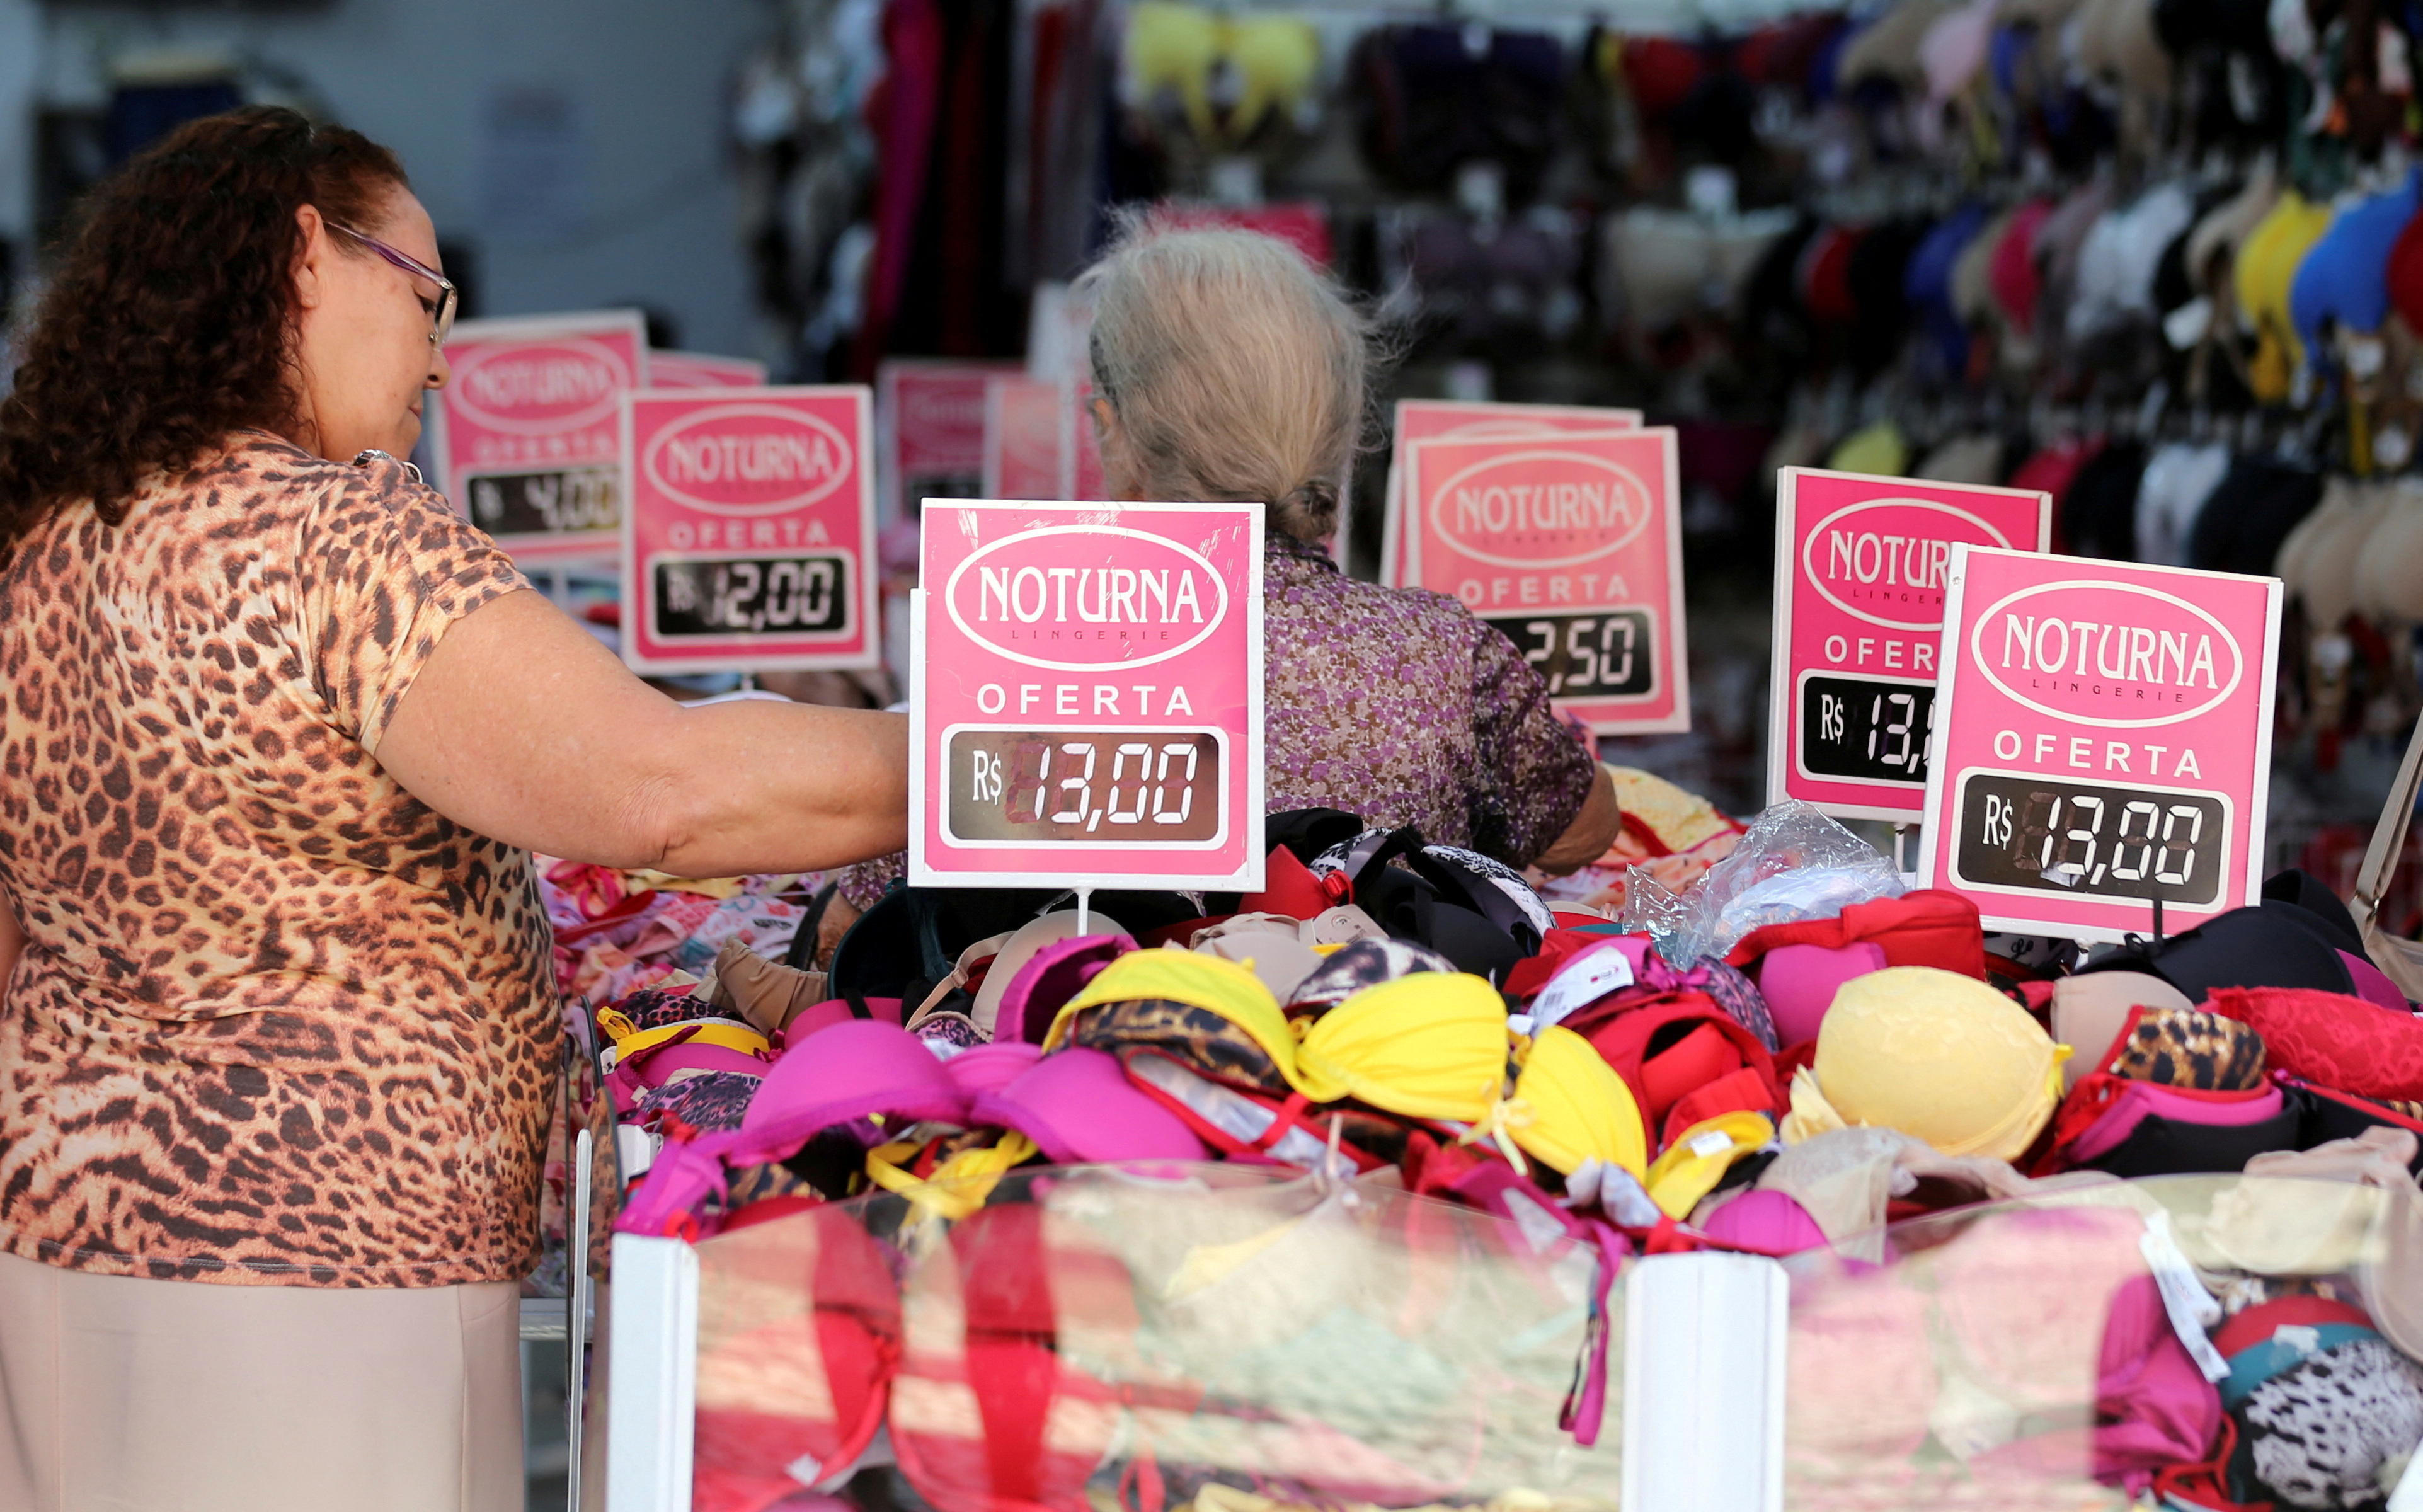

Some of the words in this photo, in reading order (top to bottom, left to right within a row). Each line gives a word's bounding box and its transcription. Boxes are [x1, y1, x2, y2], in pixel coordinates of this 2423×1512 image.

[667, 434, 835, 483] NOTURNA
[1456, 481, 1633, 534] NOTURNA
[668, 518, 830, 549] OFERTA
[1828, 530, 1951, 590] NOTUR
[701, 563, 833, 630] 12,00
[978, 566, 1204, 624] NOTURNA
[1458, 573, 1630, 606] OFERTA
[1853, 589, 1942, 605] LINGER
[1011, 630, 1169, 641] LINGERIE
[1824, 634, 1934, 672] OFER
[2002, 614, 2218, 689] NOTURNA
[977, 684, 1194, 716] OFERTA
[2032, 679, 2184, 703] LINGERIE
[1821, 694, 1844, 745] R$
[1867, 693, 1935, 774] 13,
[1993, 730, 2202, 780] OFERTA
[972, 750, 1002, 805] R$
[1034, 742, 1198, 832] 13,00
[1982, 794, 2014, 851] R$
[2041, 795, 2204, 886] 13,00
